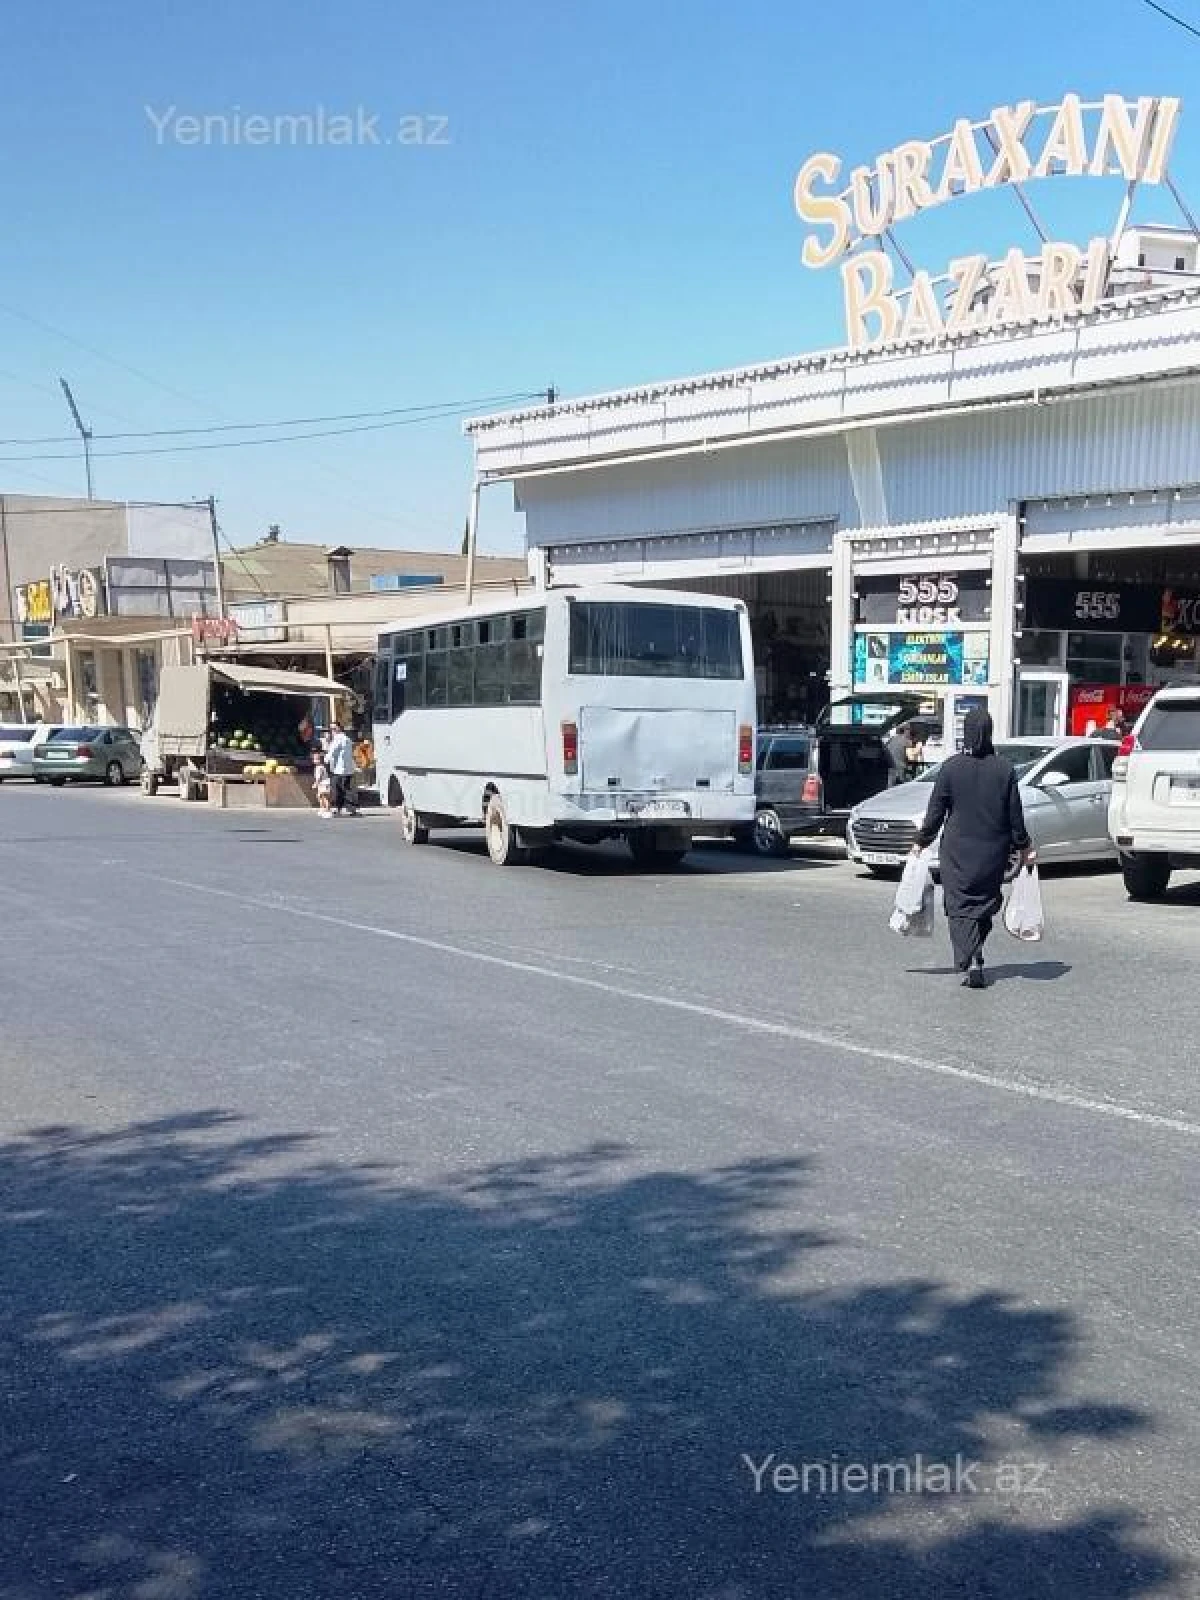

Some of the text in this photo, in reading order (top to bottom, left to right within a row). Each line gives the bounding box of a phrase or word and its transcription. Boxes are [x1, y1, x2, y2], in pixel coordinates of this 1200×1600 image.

[794, 93, 1181, 268] SURAXANI
[841, 237, 1110, 349] BAZARI
[898, 574, 959, 603] 555
[895, 607, 961, 624] KIOSK
[1075, 591, 1121, 619] 555
